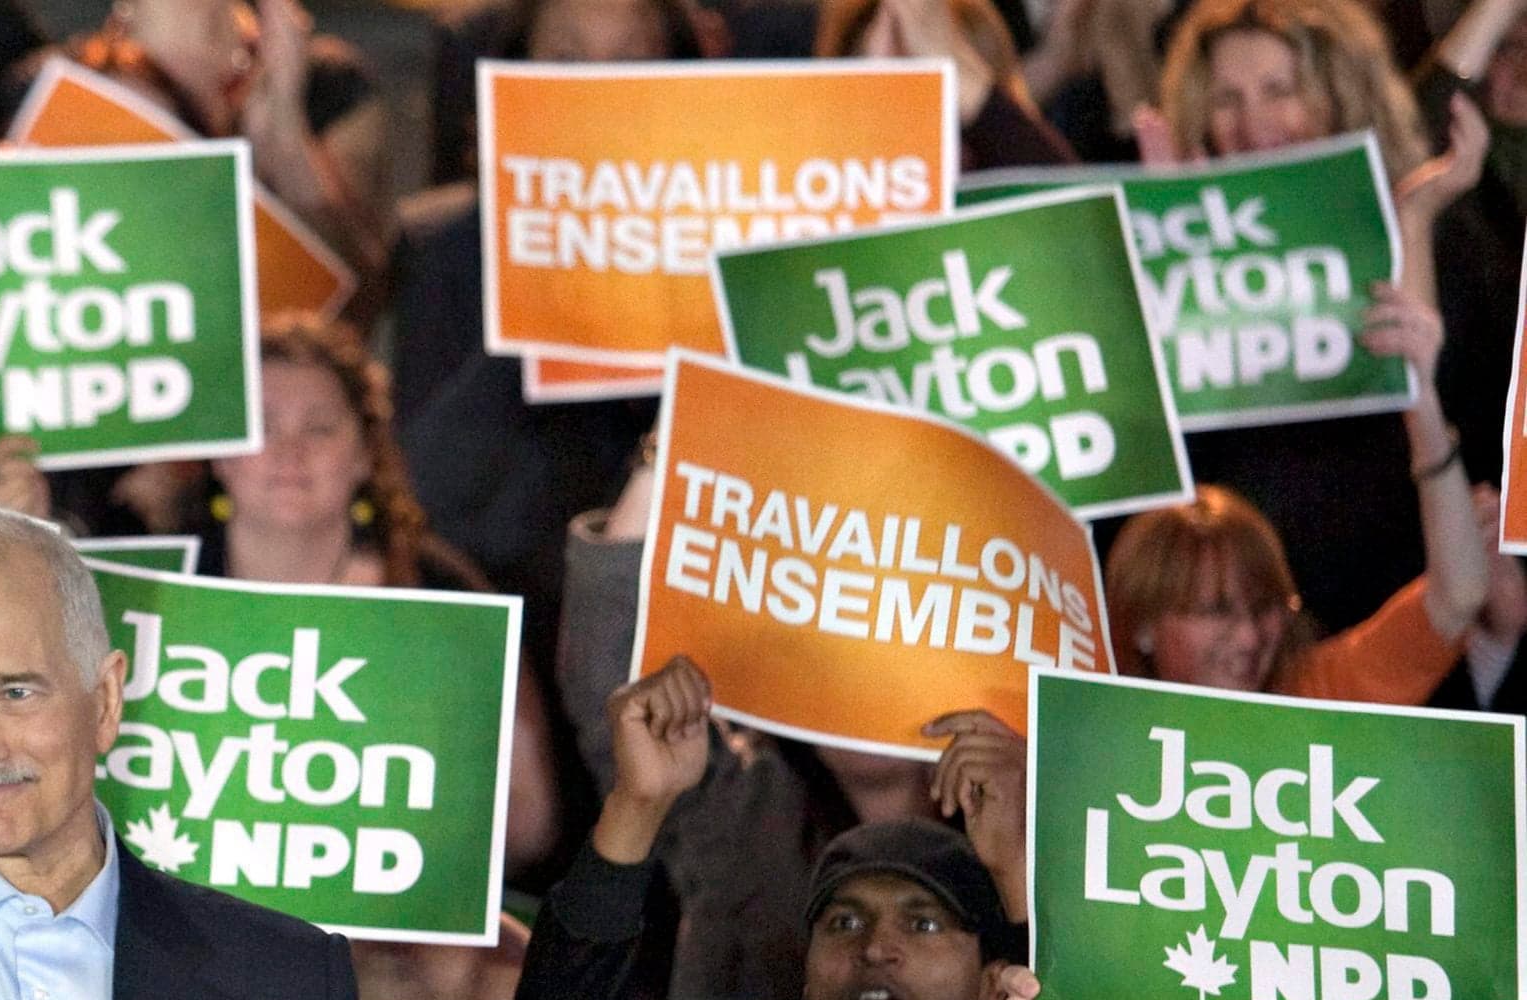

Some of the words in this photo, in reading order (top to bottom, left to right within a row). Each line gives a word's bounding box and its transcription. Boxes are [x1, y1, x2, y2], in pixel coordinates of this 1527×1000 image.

[502, 154, 931, 211] TRAVAILLONS
[1129, 187, 1278, 258] ack
[506, 208, 938, 276] ENSE
[805, 249, 1027, 358] Jack
[1140, 247, 1350, 336] yton
[3, 357, 193, 431] NPD
[1178, 318, 1353, 391] NPD
[988, 410, 1117, 481] PD
[676, 462, 1093, 633] TRAVAILLONS
[665, 523, 1096, 670] ENSEMBLE
[121, 610, 368, 722] Jack
[95, 722, 436, 819] ayton
[1116, 726, 1385, 843] Jack
[209, 819, 424, 894] NPD
[1084, 807, 1456, 940] Layton
